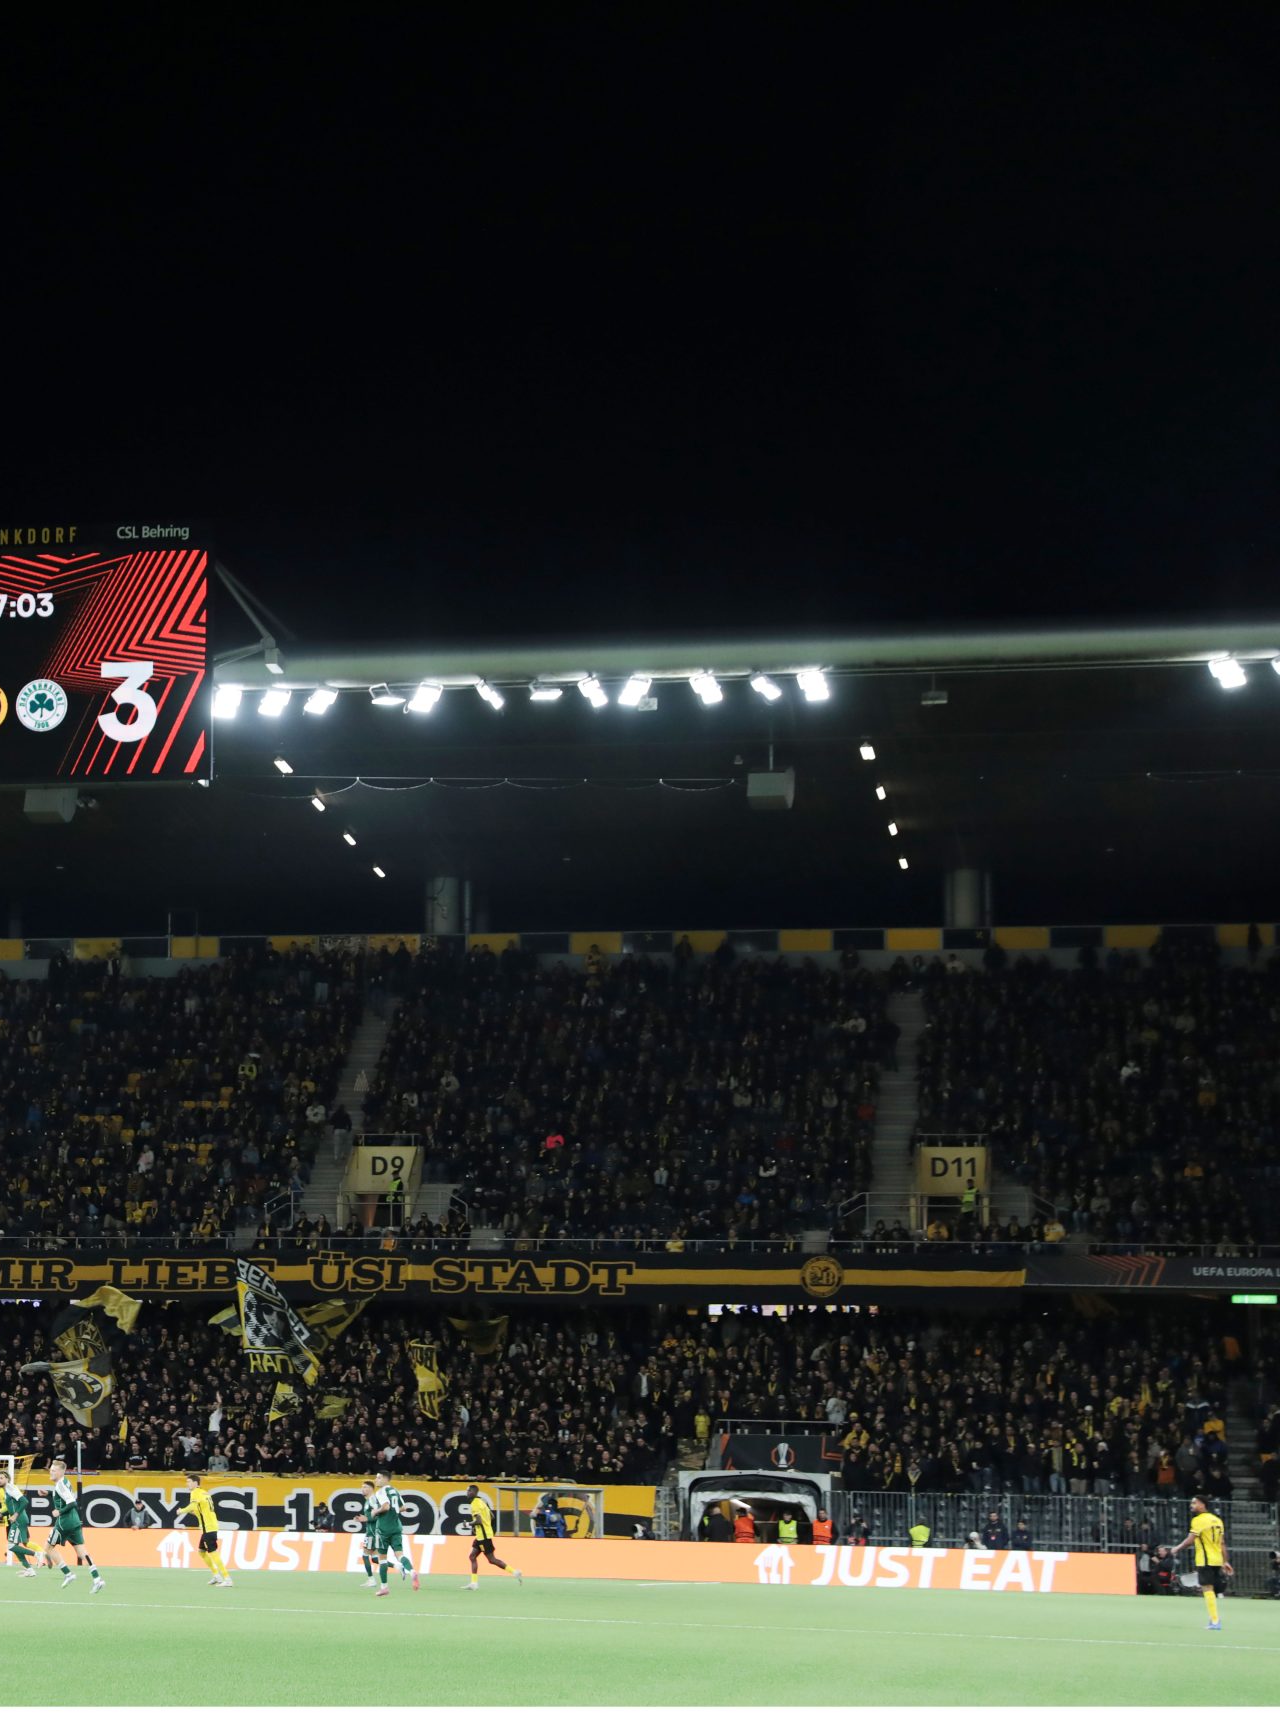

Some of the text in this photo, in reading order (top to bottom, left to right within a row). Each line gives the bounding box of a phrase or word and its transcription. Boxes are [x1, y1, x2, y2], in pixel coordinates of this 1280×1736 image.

[116, 525, 190, 540] CSL Behring
[97, 661, 158, 743] 3
[371, 1155, 405, 1176] D9
[931, 1157, 976, 1177] D11
[106, 1258, 278, 1292] LIEB
[308, 1250, 408, 1292] ÜSI
[430, 1257, 636, 1295] STADT
[1192, 1266, 1225, 1277] UEFA
[1226, 1267, 1274, 1277] EUROPA
[14, 1484, 258, 1532] BOYS
[283, 1488, 496, 1537] 1898
[810, 1545, 1068, 1593] JUST EAT
